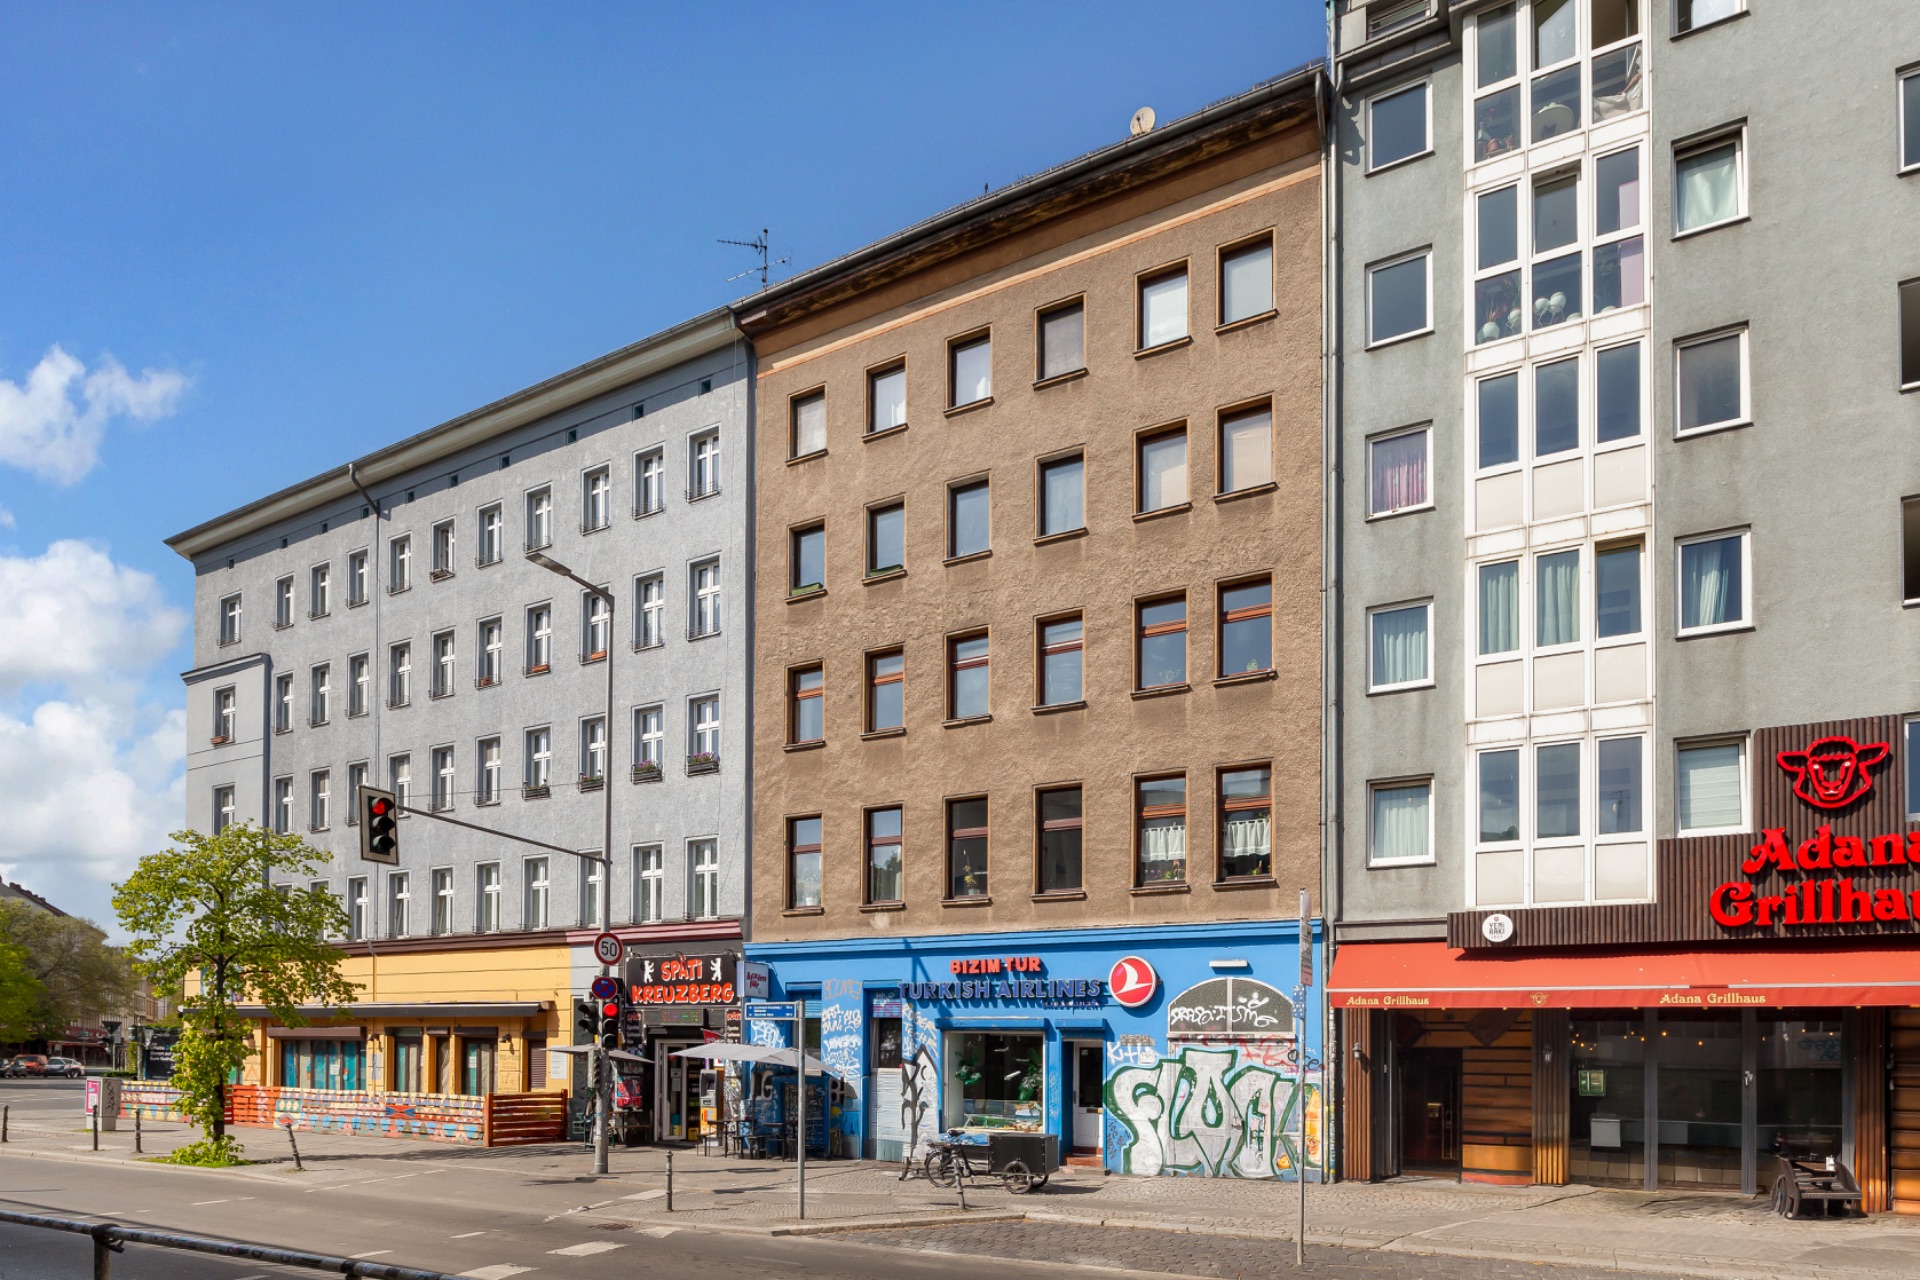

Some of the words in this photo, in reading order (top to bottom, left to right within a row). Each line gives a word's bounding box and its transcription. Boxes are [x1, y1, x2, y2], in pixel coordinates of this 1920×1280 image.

[601, 941, 618, 957] 50
[950, 957, 1000, 974] BIZIM
[1005, 956, 1042, 972] TUR
[631, 982, 734, 1004] KREUZBERG
[898, 980, 990, 1000] TURKISH
[996, 978, 1101, 999] AIRLINES
[1346, 995, 1379, 1005] Adana
[1383, 995, 1430, 1006] Grillhaus
[1660, 993, 1702, 1004] Adana
[1707, 992, 1766, 1004] Grillhaus
